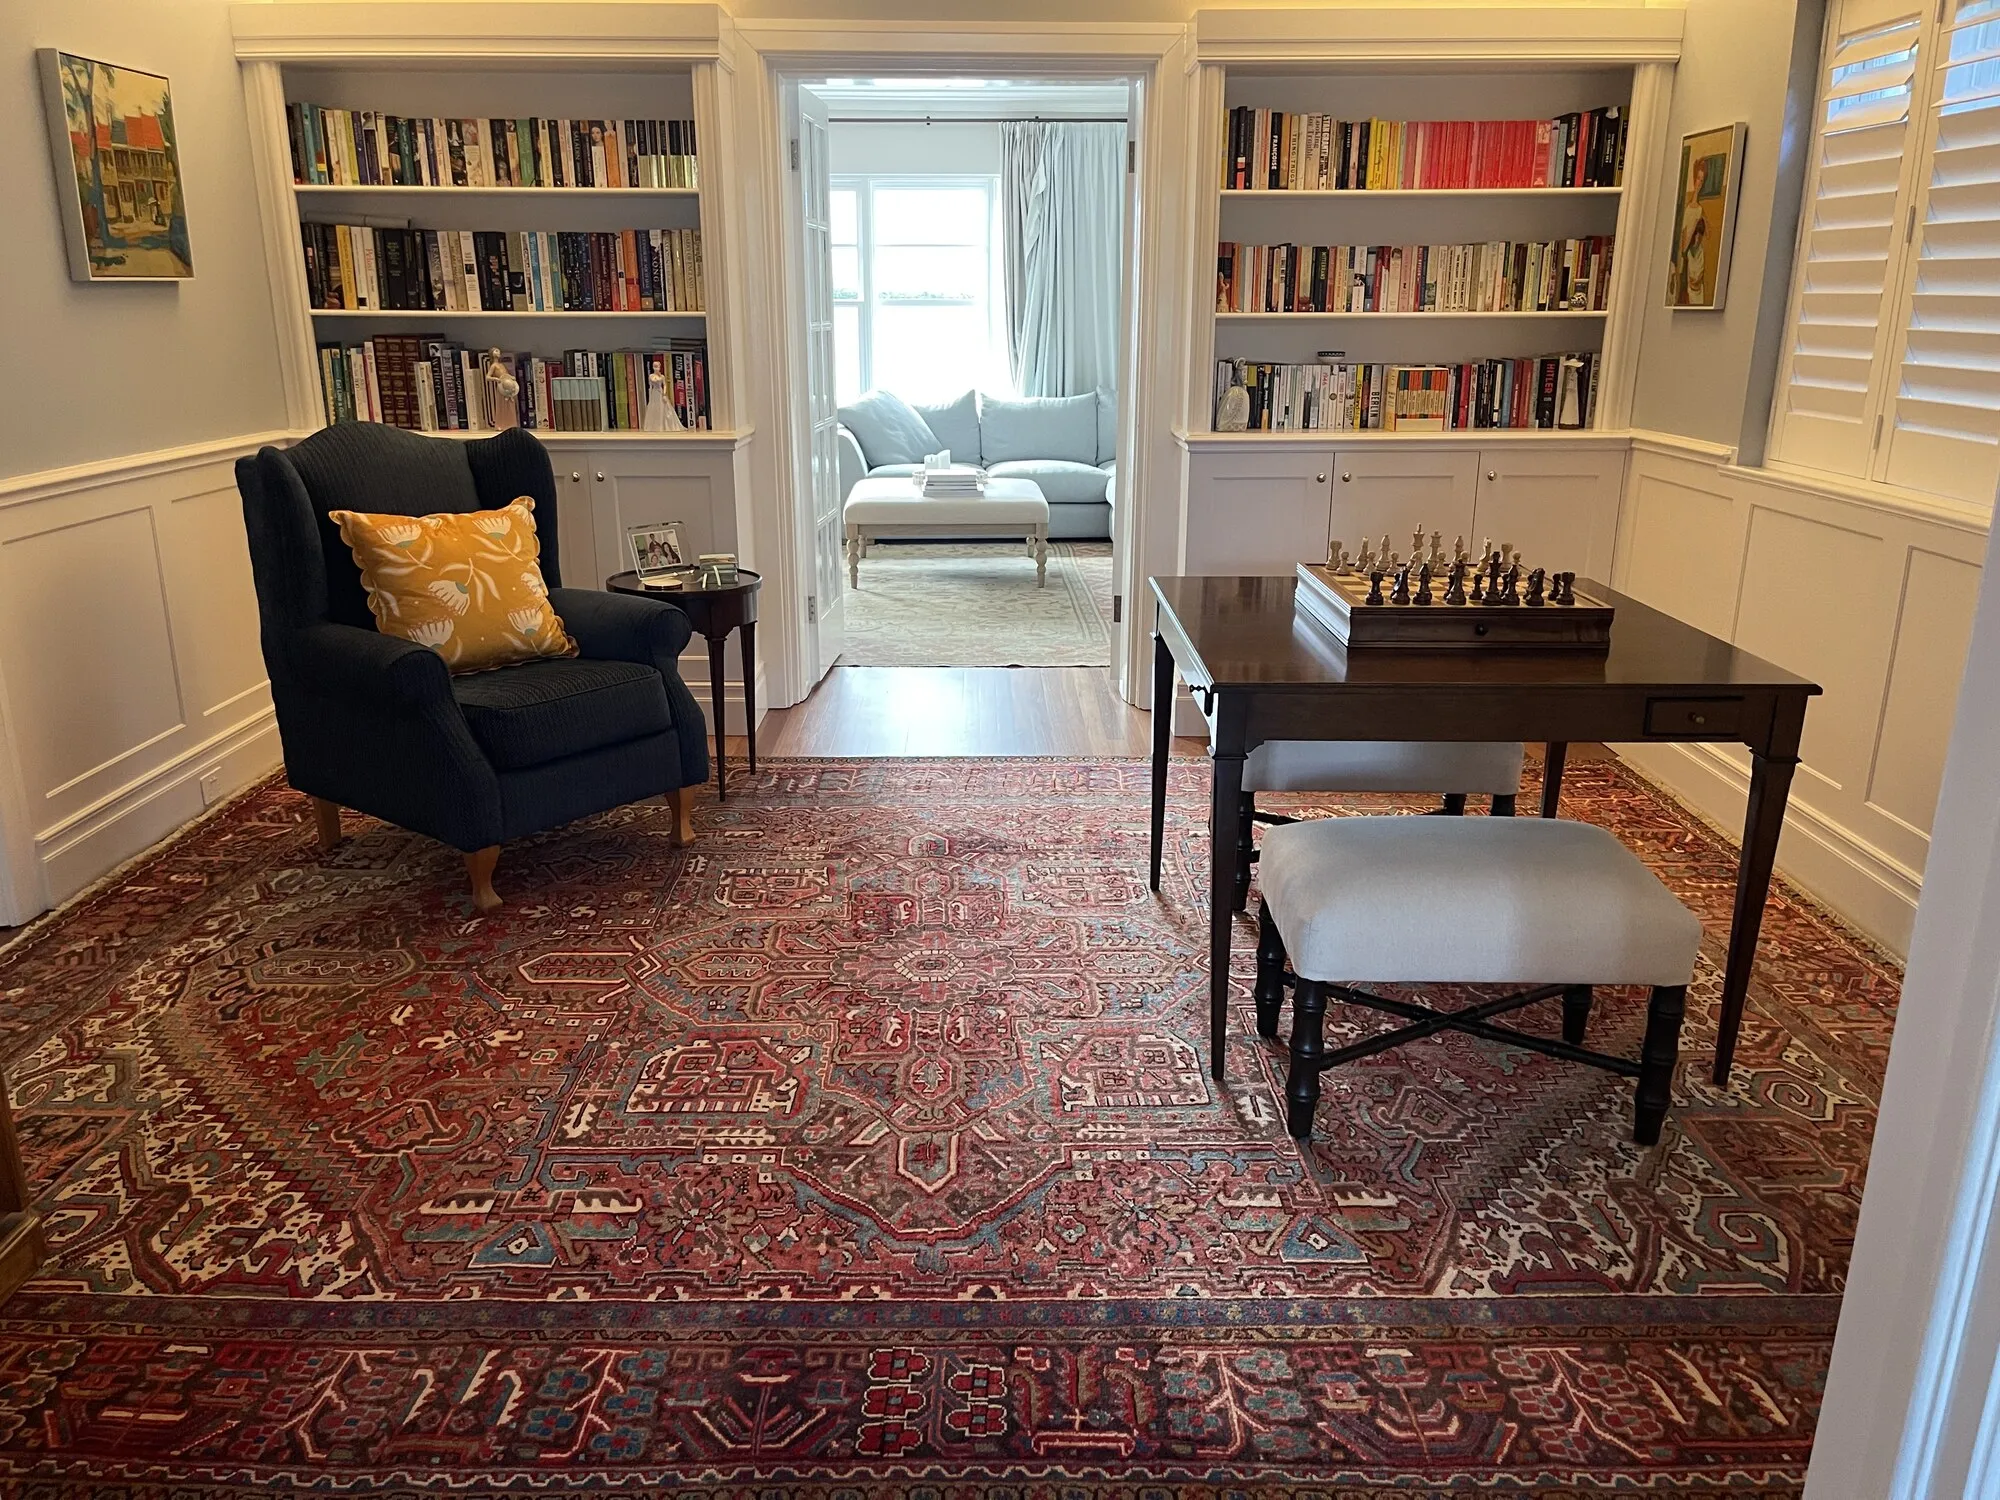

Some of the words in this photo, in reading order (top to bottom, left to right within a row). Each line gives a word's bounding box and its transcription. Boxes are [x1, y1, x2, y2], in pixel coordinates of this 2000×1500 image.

[1306, 131, 1314, 160] Trouble
[1313, 116, 1322, 149] Looking
[1271, 135, 1279, 170] FRANÇOISE
[455, 364, 464, 403] BIBLIOPHILE
[1544, 364, 1555, 394] HITLER
[1370, 391, 1380, 418] BERLIN
